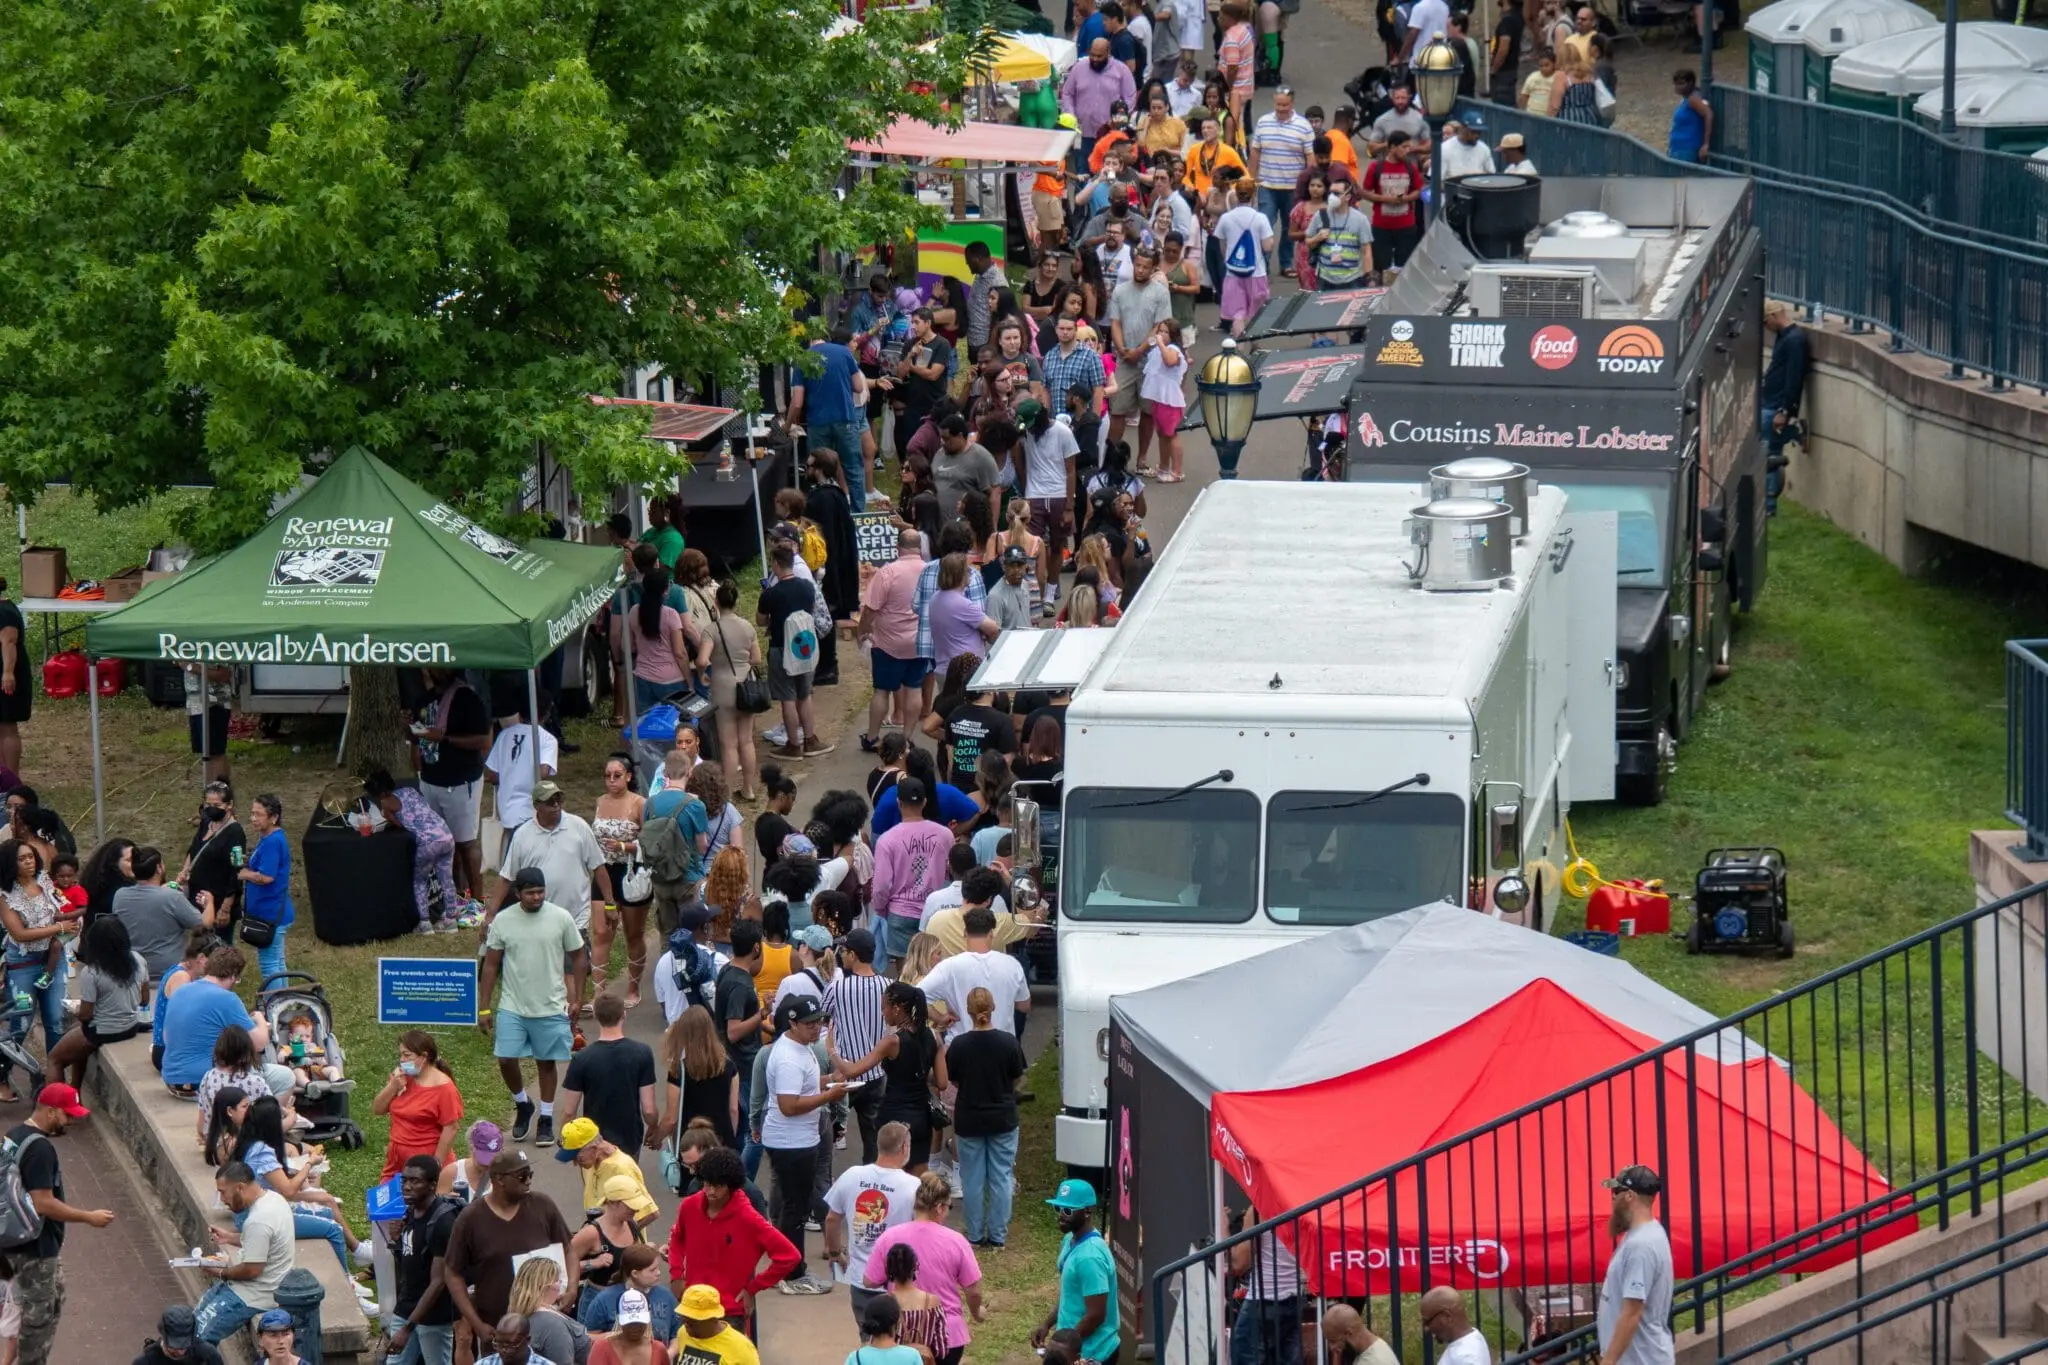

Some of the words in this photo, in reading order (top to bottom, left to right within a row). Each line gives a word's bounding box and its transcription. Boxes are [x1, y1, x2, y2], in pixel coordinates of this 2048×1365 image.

[1450, 323, 1507, 345] SHARK
[1388, 341, 1414, 349] GOOD
[1531, 334, 1577, 359] food
[1376, 353, 1424, 363] AMERICA
[1450, 343, 1506, 368] TANK
[1597, 358, 1664, 374] TODAY
[1389, 420, 1492, 445] Cousins
[1494, 423, 1574, 447] Maine
[1576, 425, 1674, 451] Lobster
[285, 516, 394, 536] Renewal
[855, 524, 899, 537] CON
[856, 535, 898, 549] FFLE
[859, 548, 899, 561] RGER
[958, 739, 978, 747] ANTI
[902, 832, 938, 857] VANITY
[1329, 1244, 1463, 1272] FRONTER
